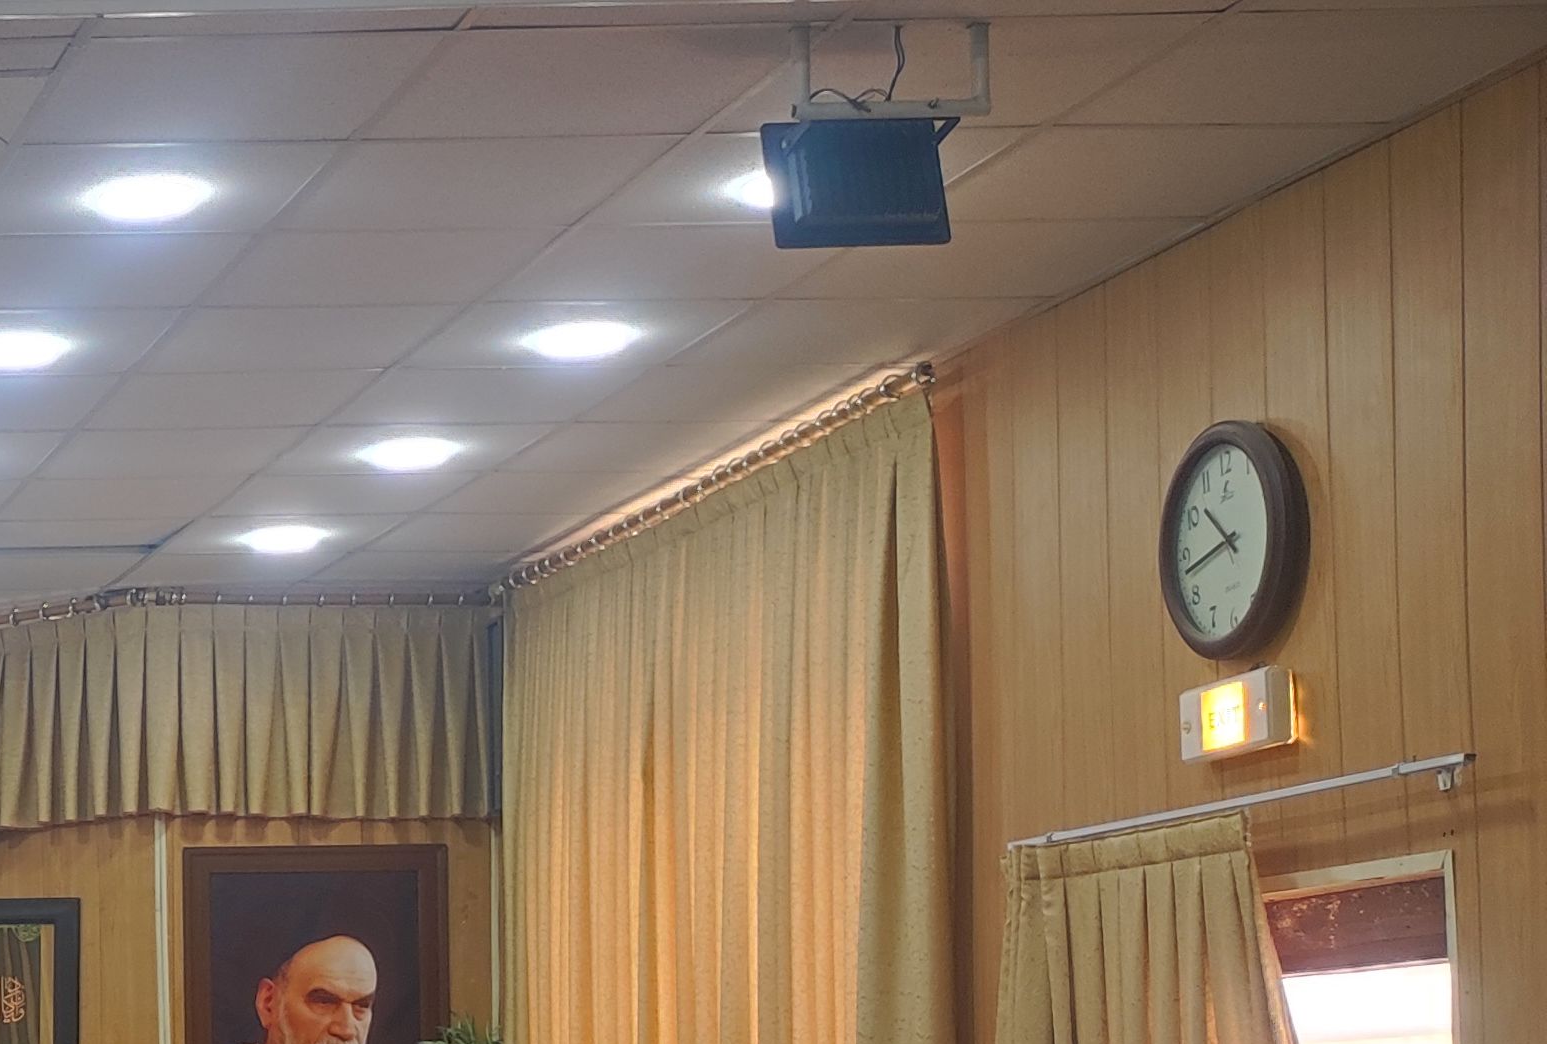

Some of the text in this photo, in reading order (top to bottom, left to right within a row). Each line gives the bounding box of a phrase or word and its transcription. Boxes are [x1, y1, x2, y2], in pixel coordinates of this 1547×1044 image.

[1219, 450, 1232, 477] 12
[1202, 471, 1210, 494] 11
[1187, 505, 1199, 530] 10
[1182, 547, 1191, 564] 9
[1191, 584, 1201, 605] 8
[1209, 605, 1217, 628] 7
[1229, 607, 1238, 629] 6
